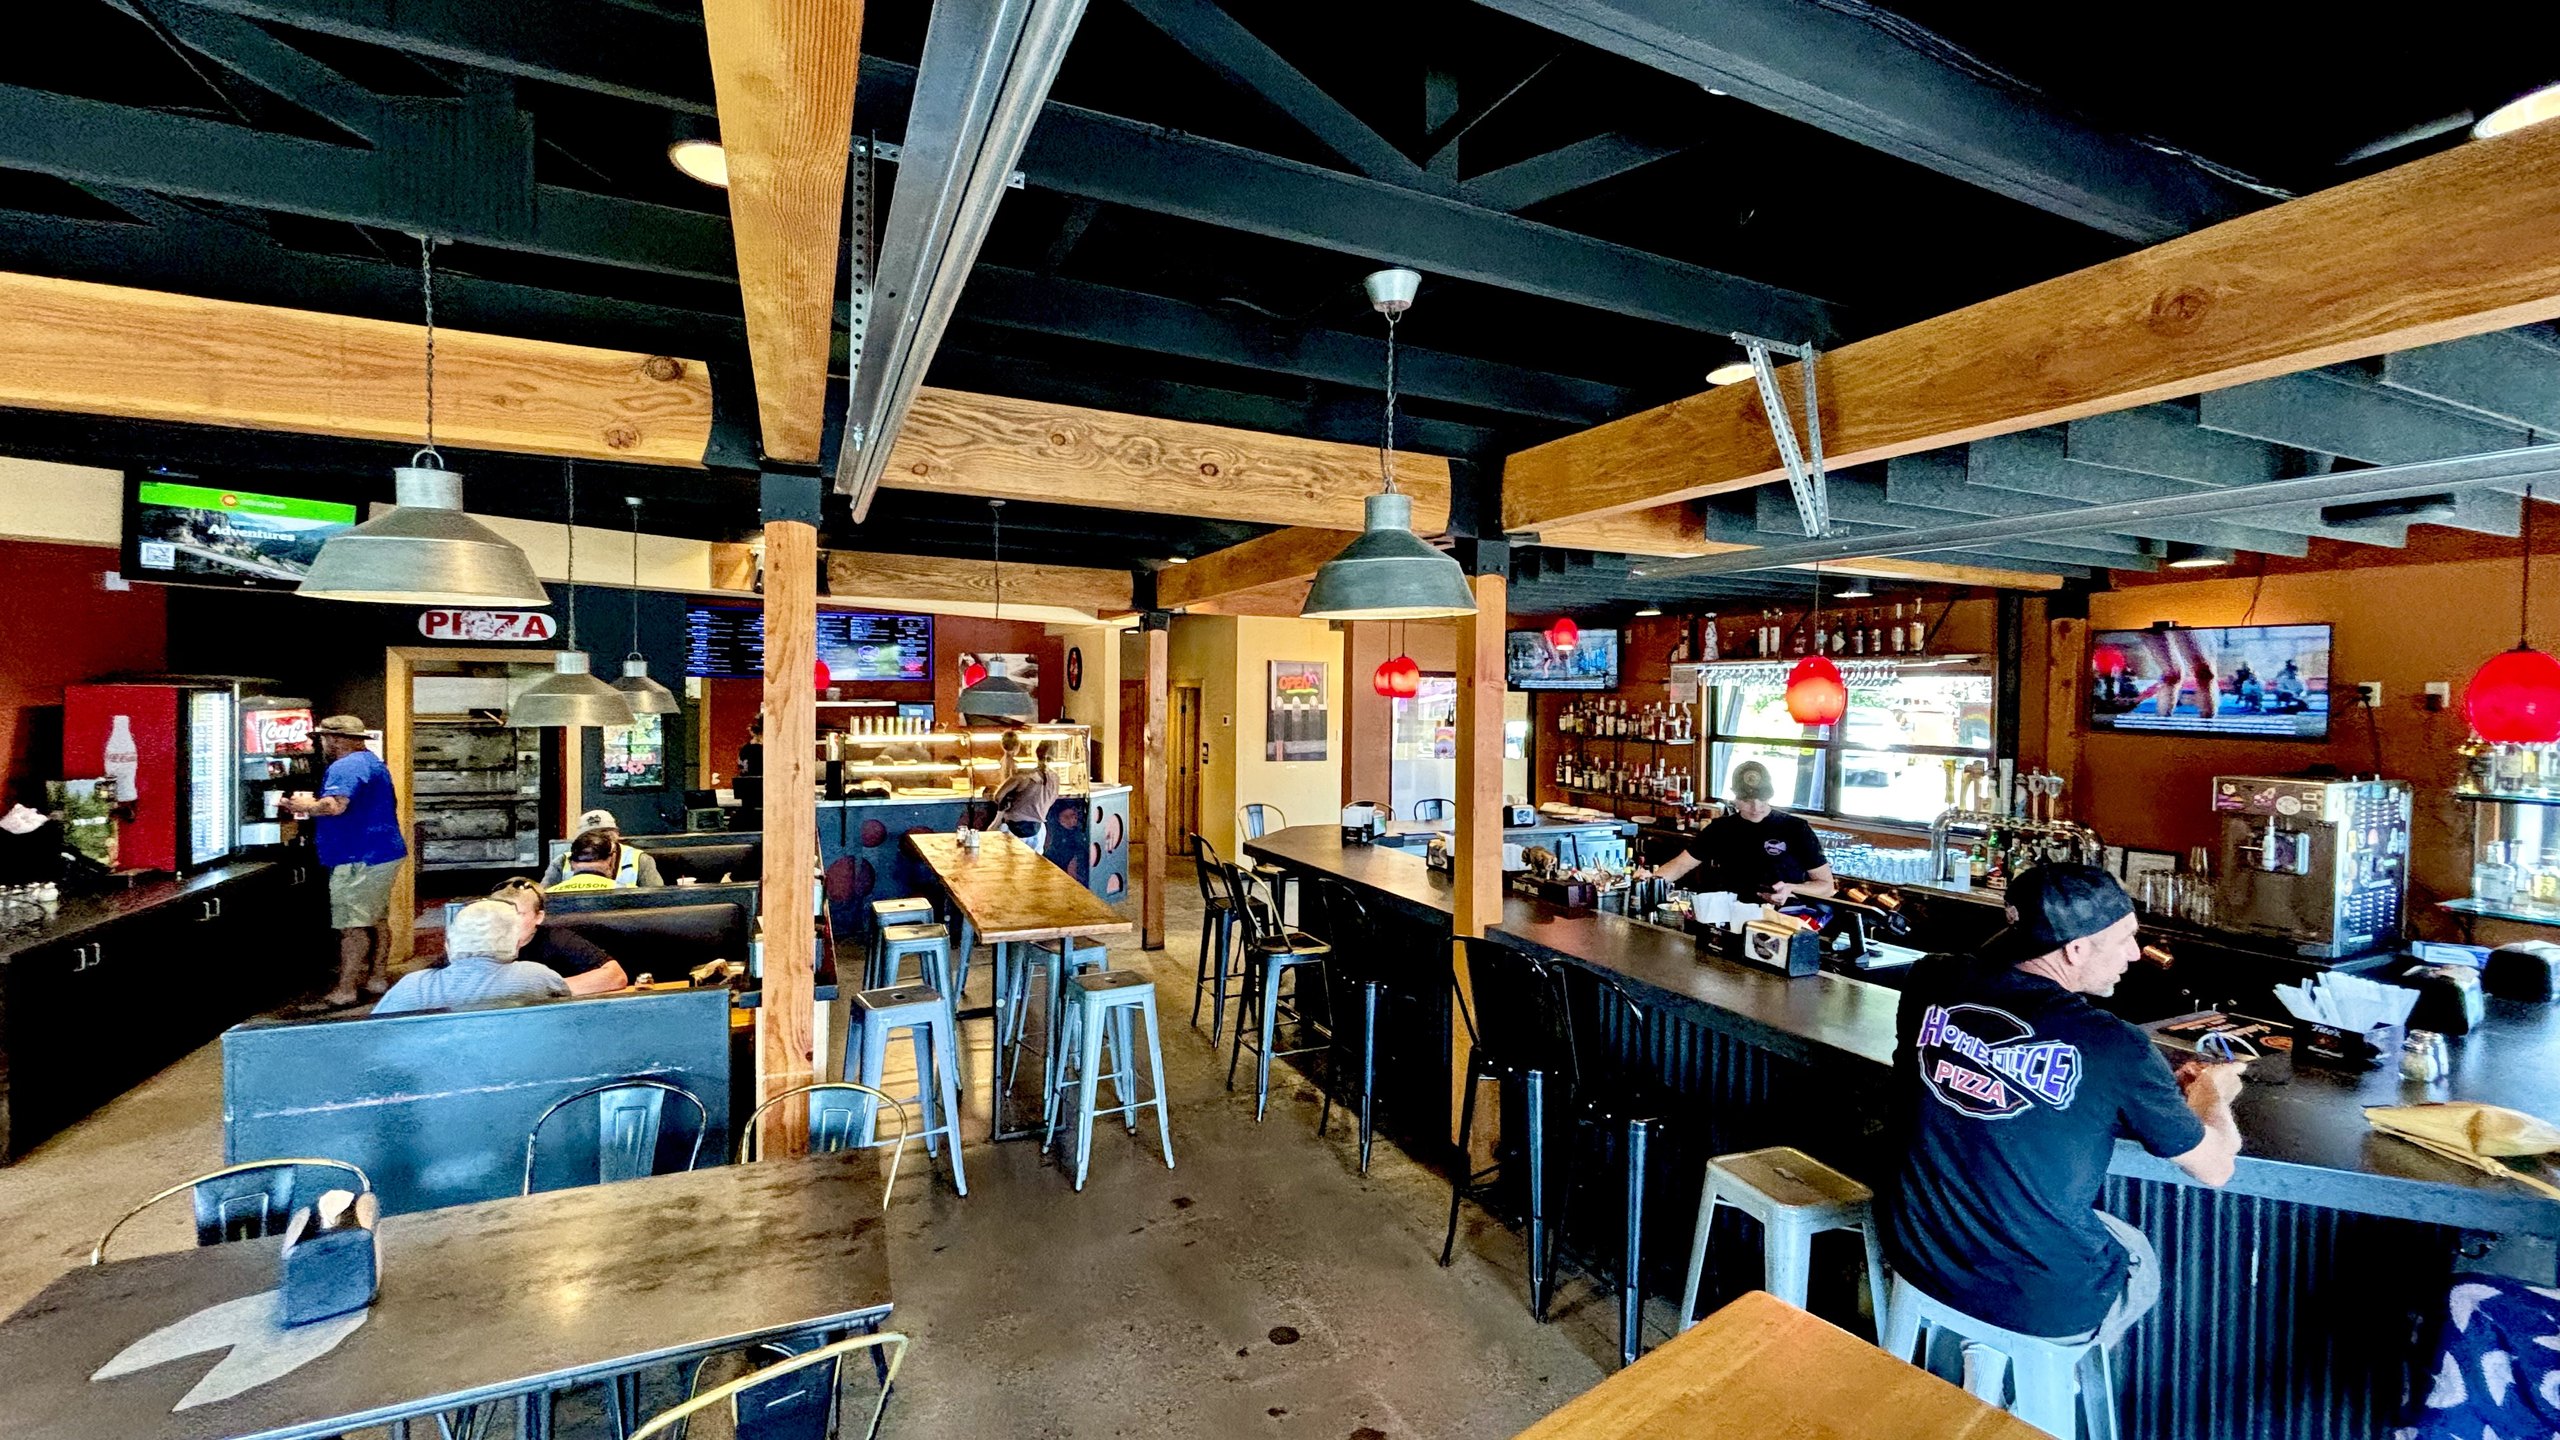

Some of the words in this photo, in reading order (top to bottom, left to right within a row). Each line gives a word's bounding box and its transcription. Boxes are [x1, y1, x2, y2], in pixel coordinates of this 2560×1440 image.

[207, 523, 296, 542] Adventures
[425, 611, 548, 639] PIZA
[1916, 1004, 1989, 1066] HOME
[1934, 1060, 2007, 1108] PIZZA
